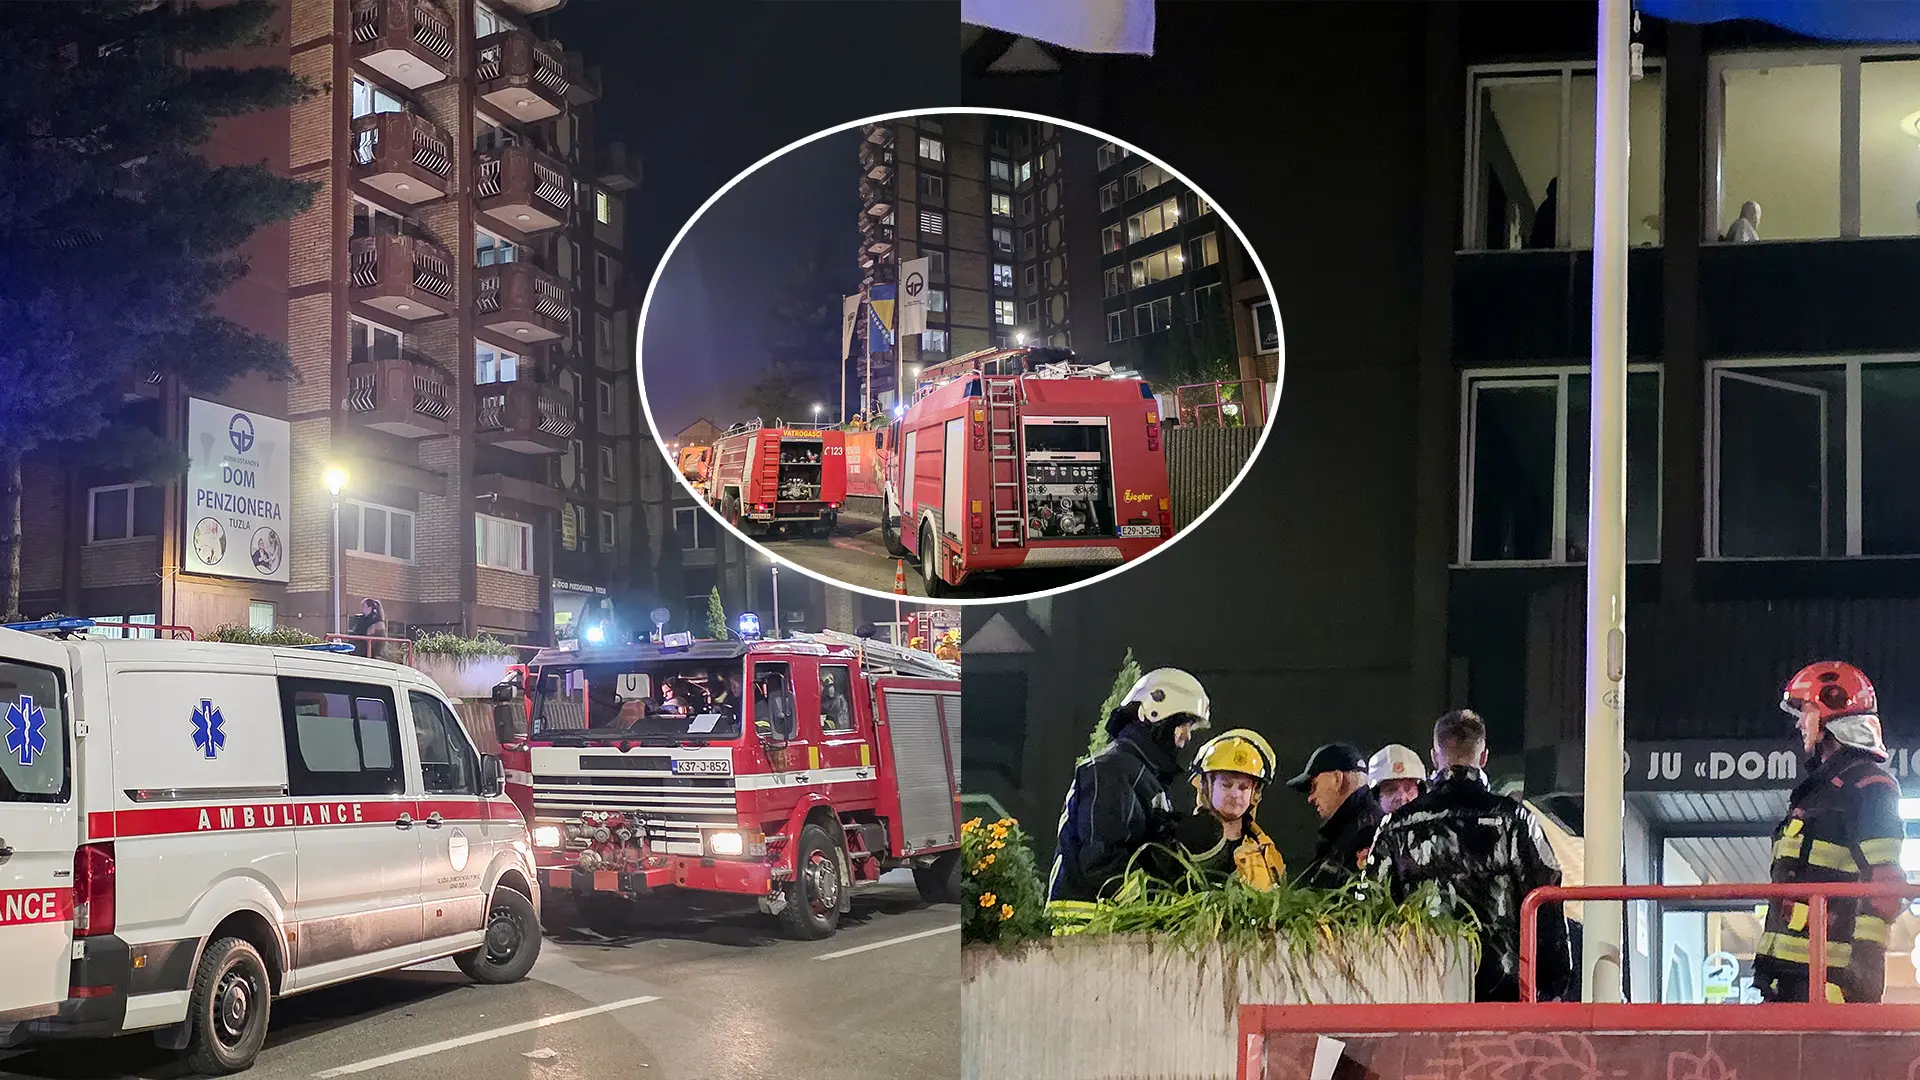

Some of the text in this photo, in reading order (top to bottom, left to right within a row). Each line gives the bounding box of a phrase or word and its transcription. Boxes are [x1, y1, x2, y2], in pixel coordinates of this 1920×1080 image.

[783, 430, 823, 438] VATROGASCI
[830, 446, 843, 456] 123
[223, 466, 256, 489] DOM
[197, 488, 282, 521] PENZIONERA
[1124, 489, 1153, 503] Ziegler
[229, 518, 251, 530] TUZLA
[678, 761, 728, 772] K37-J-852
[1647, 751, 1682, 780] JU
[198, 803, 364, 830] AMBULANCE
[0, 892, 56, 921] NCE
